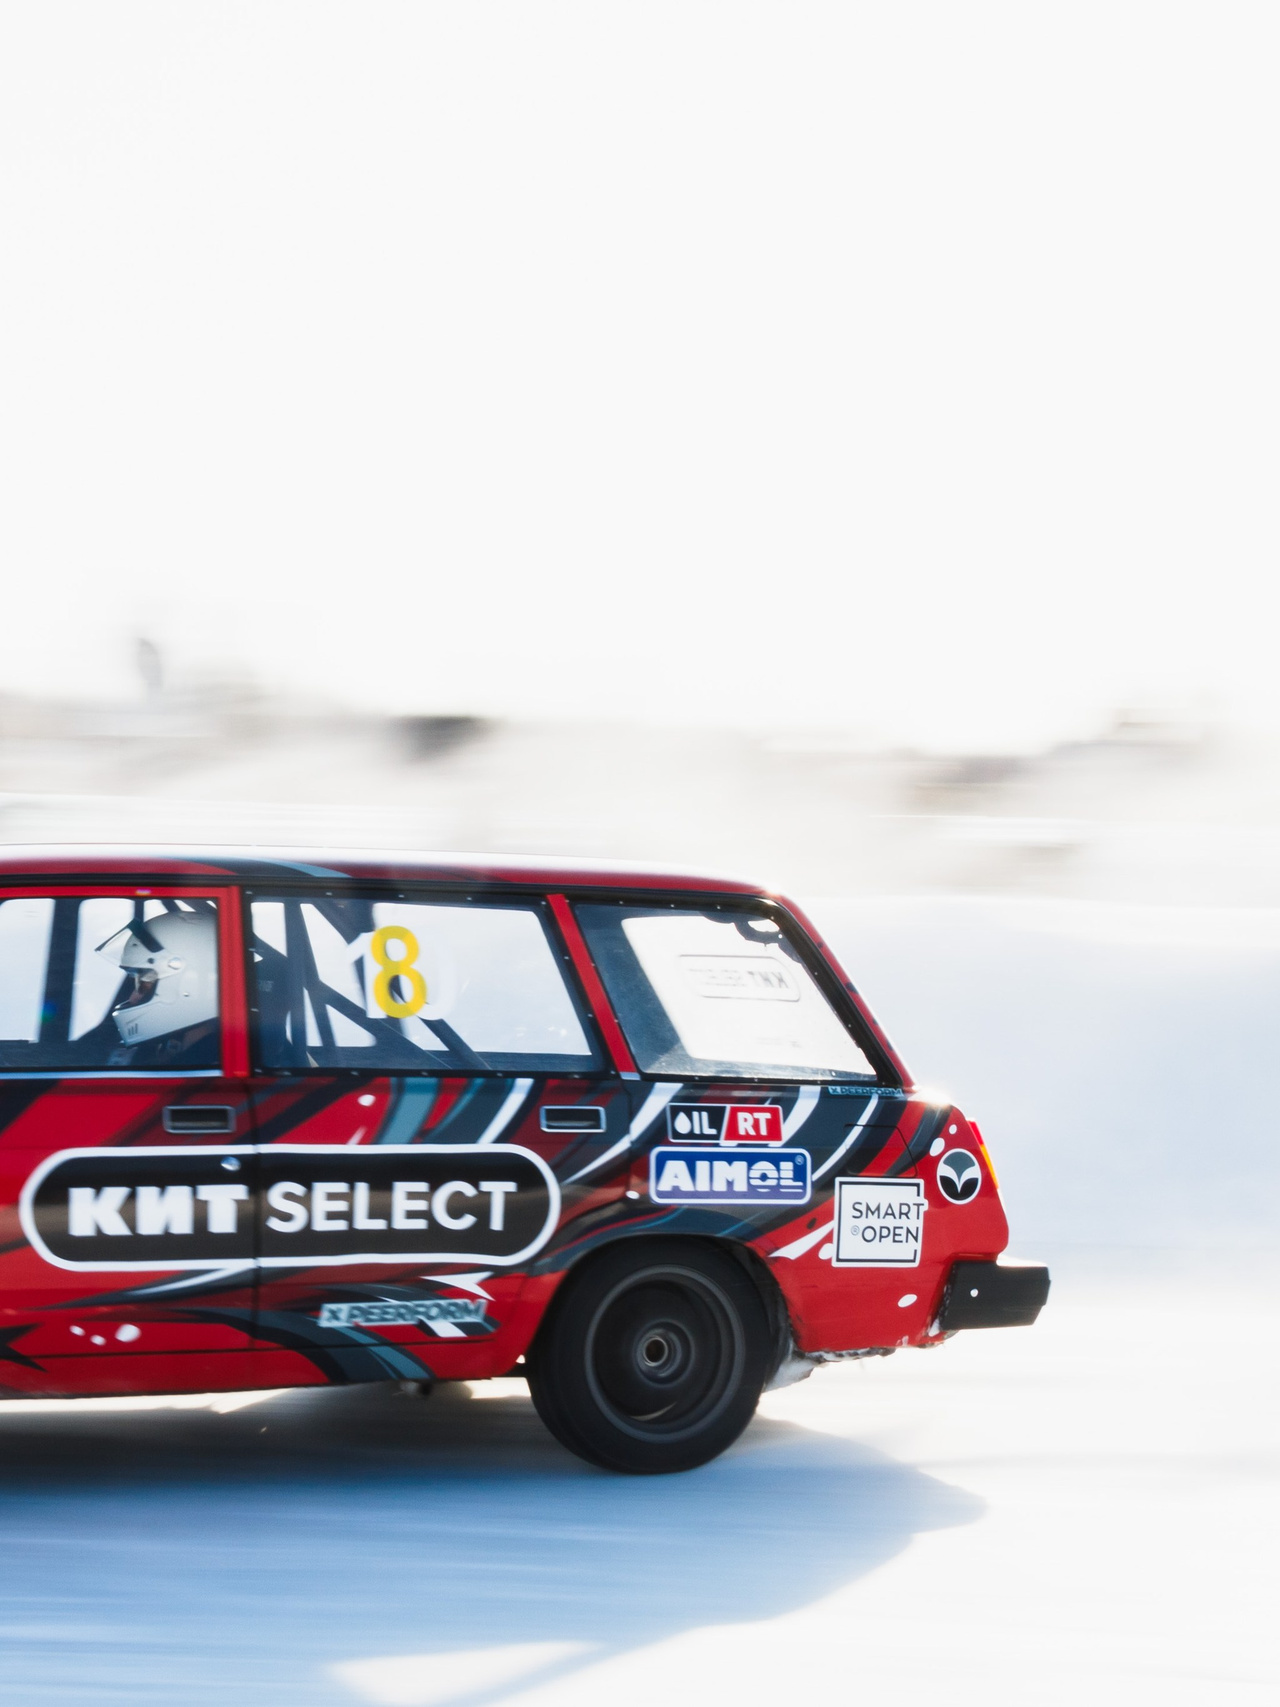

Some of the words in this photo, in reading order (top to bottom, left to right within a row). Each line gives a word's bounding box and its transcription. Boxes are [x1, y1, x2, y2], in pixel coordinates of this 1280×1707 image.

[370, 925, 427, 1019] 8
[736, 1111, 772, 1136] RT
[656, 1159, 804, 1193] AIMOL
[67, 1184, 249, 1237] КИТ
[265, 1179, 518, 1233] SELECT
[851, 1200, 925, 1220] SMART
[861, 1225, 919, 1244] OPEN
